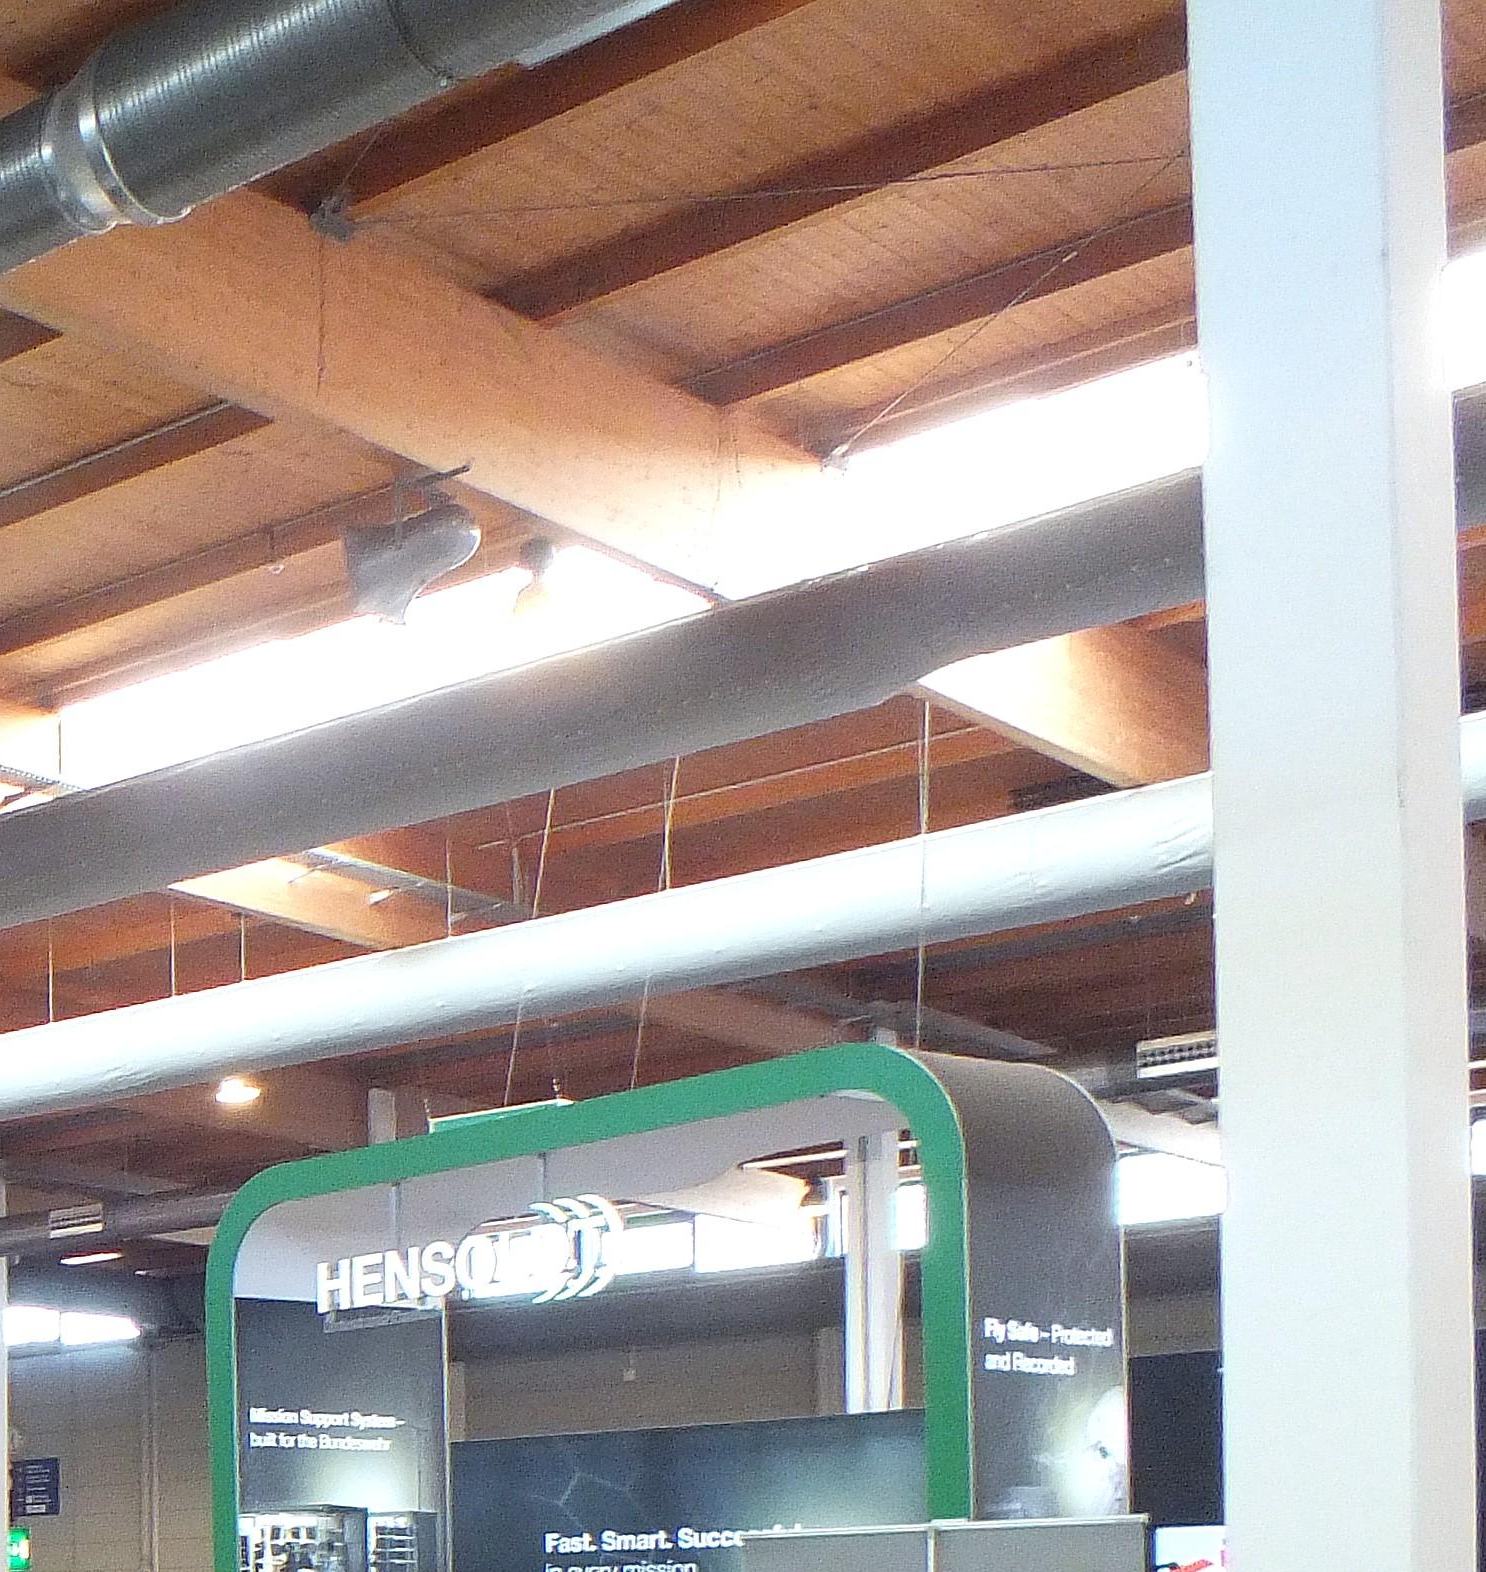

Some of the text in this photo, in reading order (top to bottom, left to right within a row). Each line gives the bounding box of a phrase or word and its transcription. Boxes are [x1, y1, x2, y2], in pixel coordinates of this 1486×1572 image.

[984, 1317, 1006, 1344] Fly
[1007, 1320, 1039, 1343] Safe
[1051, 1324, 1114, 1347] Protected
[985, 1352, 1075, 1376] and Recorded
[249, 1407, 299, 1423] Mission
[300, 1409, 350, 1428] Support
[250, 1432, 391, 1450] built for the Bundeswehr
[545, 1532, 598, 1553] Fast.
[601, 1530, 673, 1550] Smart.
